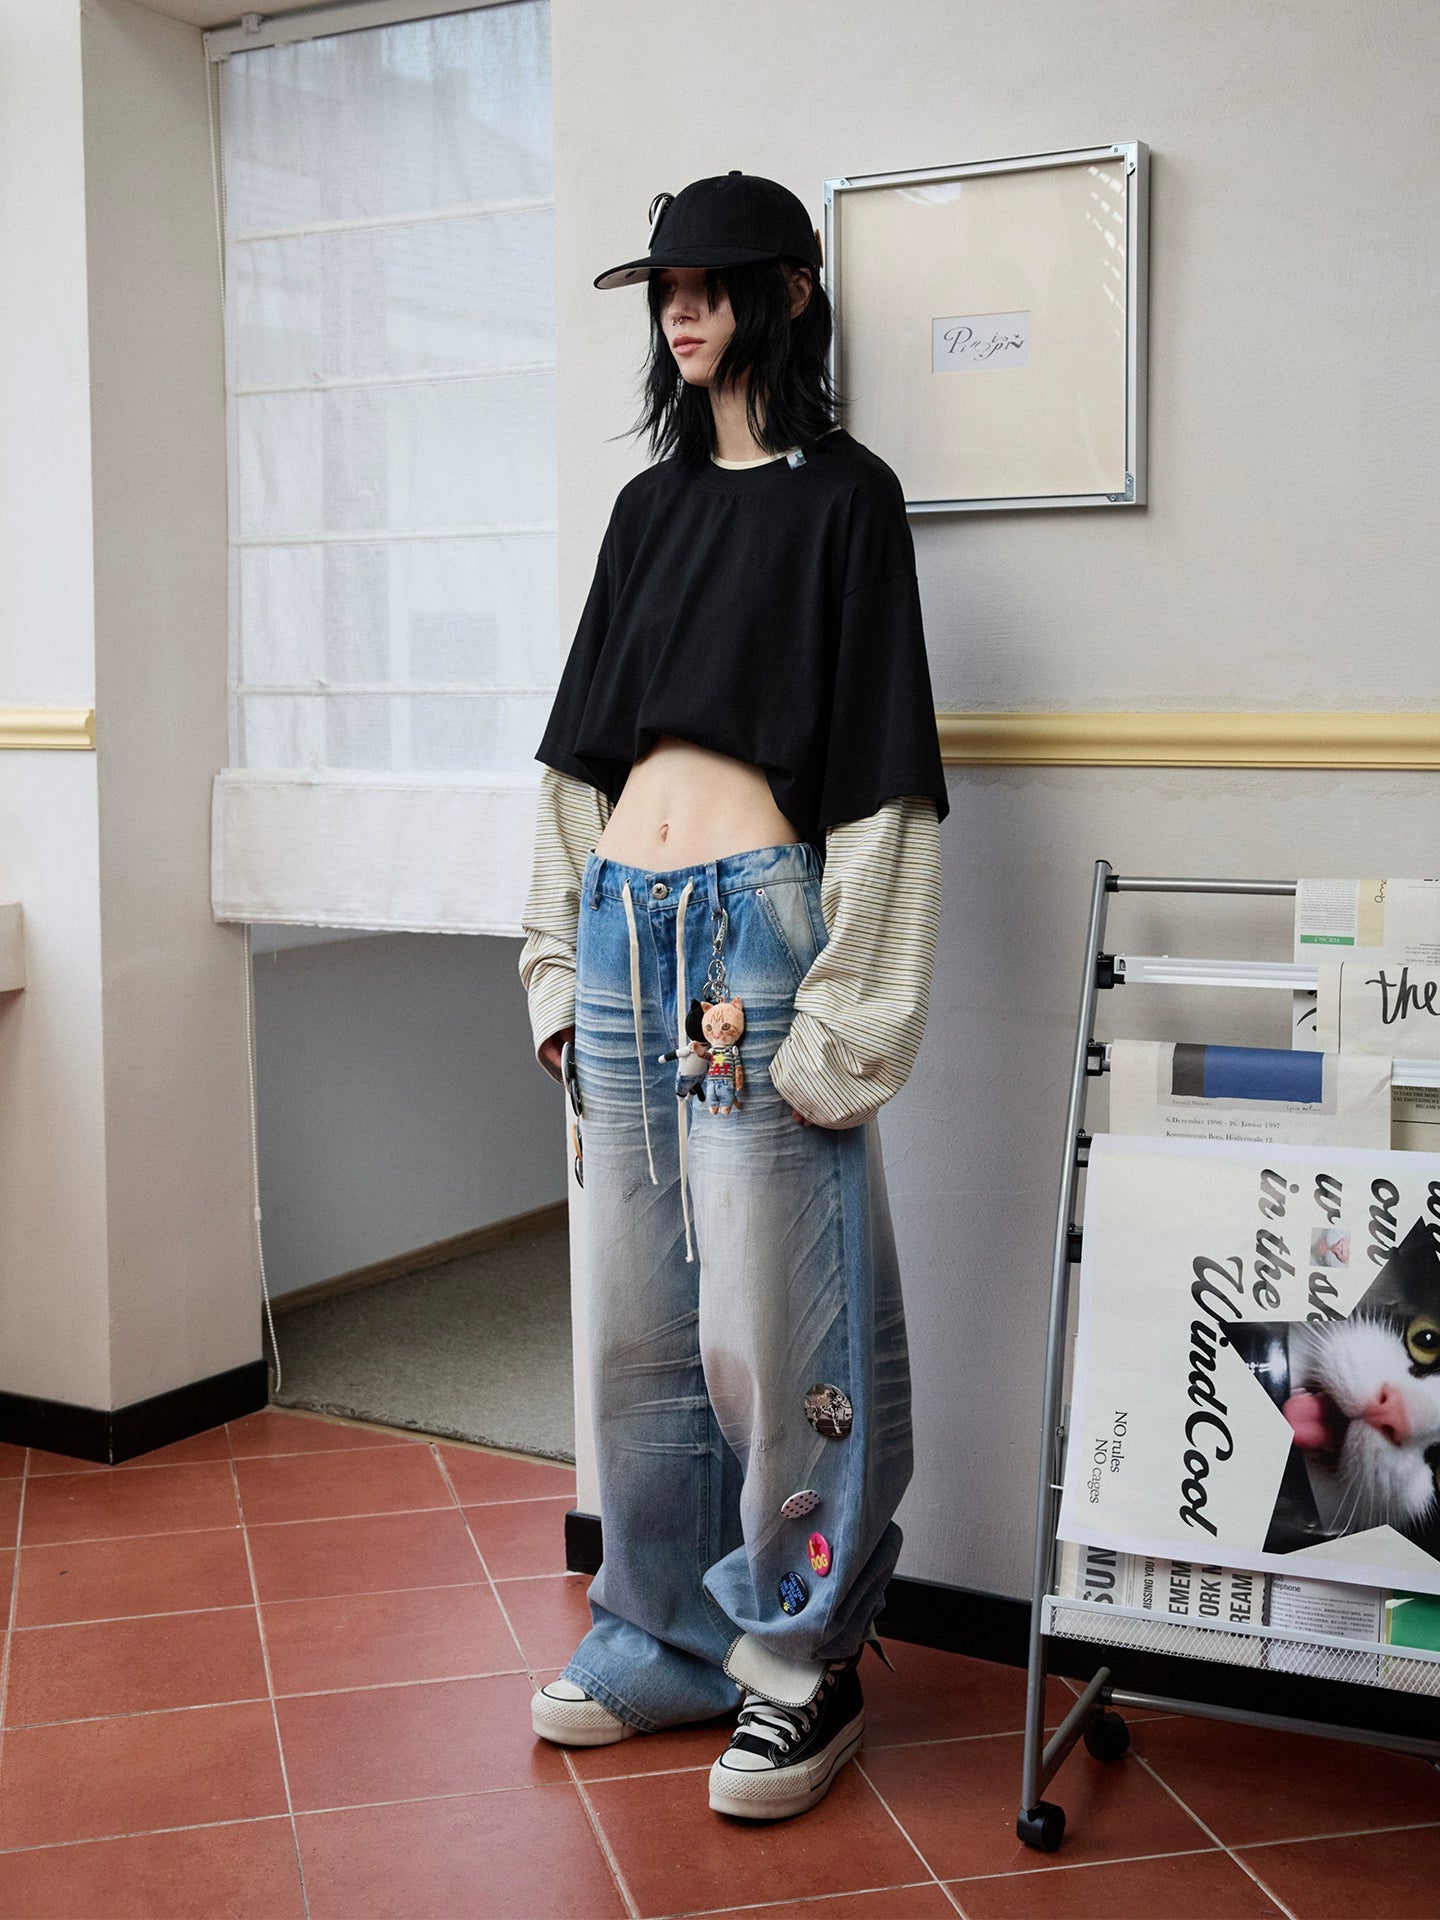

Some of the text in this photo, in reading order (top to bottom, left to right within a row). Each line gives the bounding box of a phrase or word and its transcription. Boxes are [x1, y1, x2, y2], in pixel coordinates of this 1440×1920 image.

[1365, 967, 1440, 1025] the
[1252, 1168, 1300, 1312] in the
[1108, 1410, 1128, 1474] NO rules
[1089, 1438, 1109, 1505] NO cages
[811, 1553, 829, 1571] DOG
[1143, 1560, 1155, 1577] YOU
[1199, 1578, 1223, 1619] ORK
